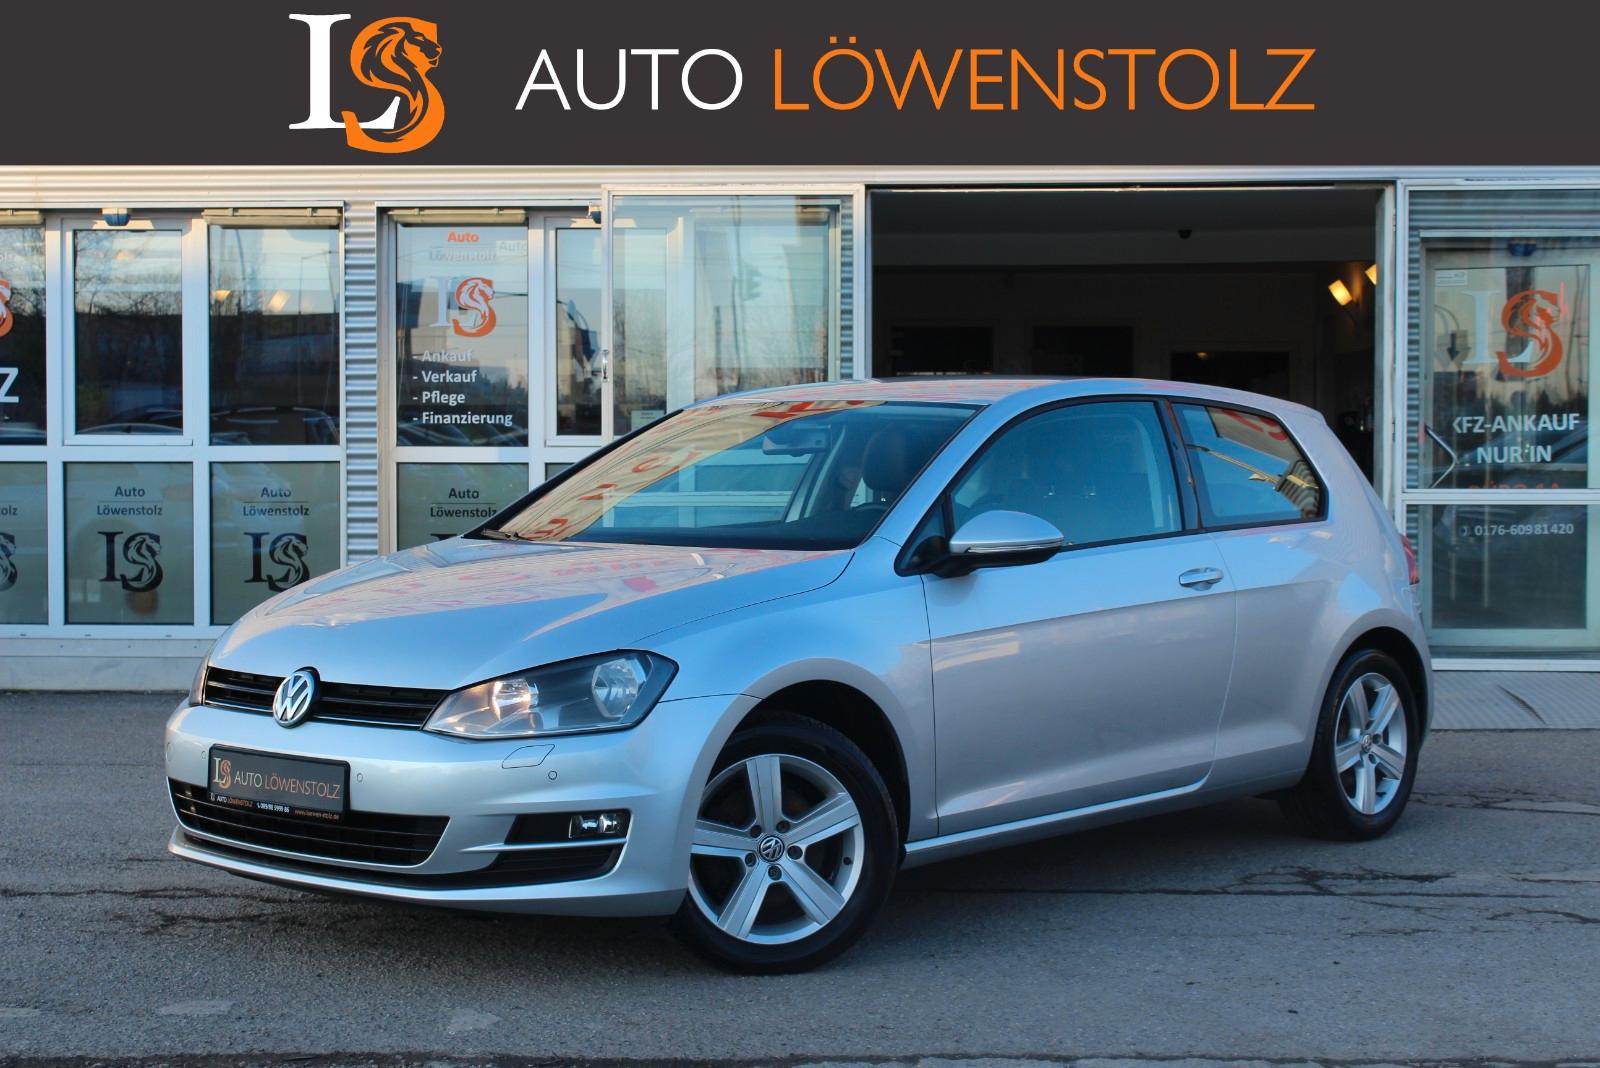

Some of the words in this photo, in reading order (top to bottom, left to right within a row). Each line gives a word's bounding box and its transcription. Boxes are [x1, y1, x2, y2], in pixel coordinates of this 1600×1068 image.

[447, 231, 480, 243] Auto
[421, 350, 473, 362] Ankauf
[421, 369, 478, 383] Verkauf
[422, 390, 466, 407] Pflege
[422, 411, 513, 427] Finanzierung
[1476, 446, 1523, 464] NUR
[1530, 445, 1552, 463] IN
[114, 485, 146, 498] Auto
[260, 486, 292, 498] Auto
[448, 487, 480, 499] Auto
[96, 504, 163, 516] Löwenstolz
[242, 504, 310, 517] Löwenstolz
[430, 506, 497, 518] Löwenstolz
[1474, 523, 1575, 536] 0176-60981420
[234, 770, 263, 788] AUTO
[264, 772, 341, 799] LÖWENSTOLZ
